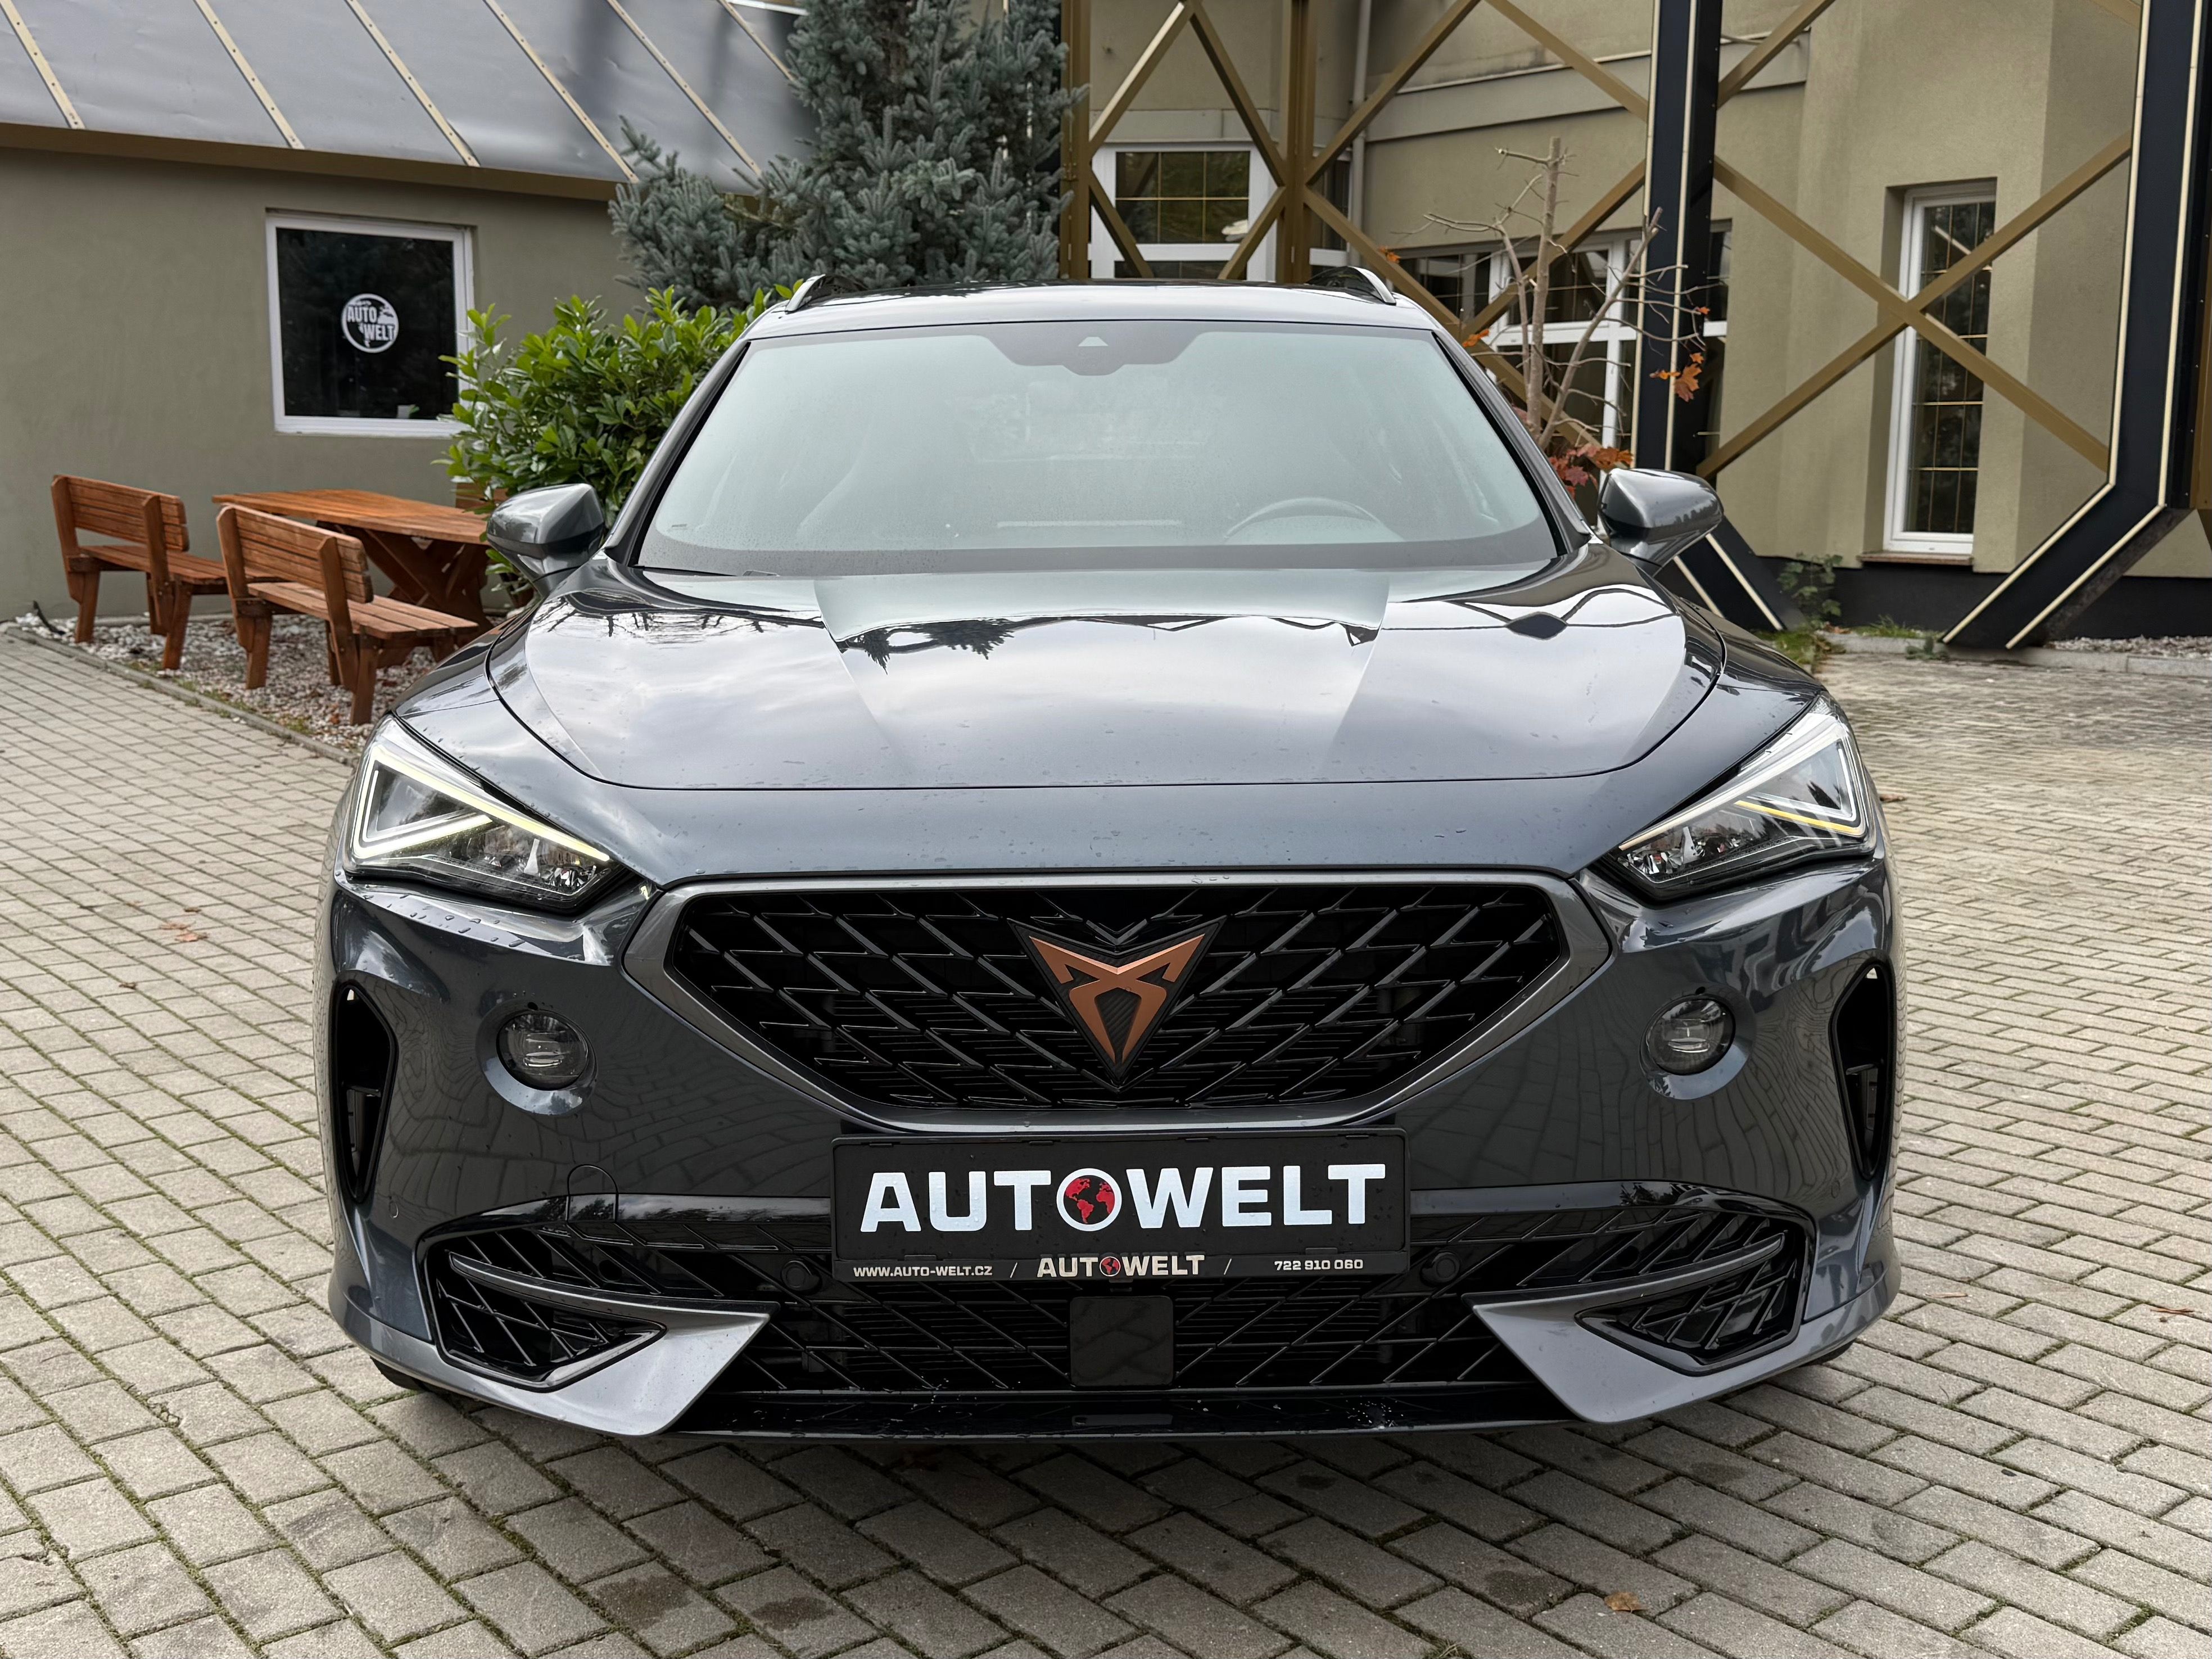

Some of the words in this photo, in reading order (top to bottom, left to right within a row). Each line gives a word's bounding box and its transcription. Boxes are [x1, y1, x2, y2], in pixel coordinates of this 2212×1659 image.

[347, 306, 377, 323] AUTO
[364, 324, 393, 341] WELT
[860, 1163, 1386, 1232] AUTOWELT
[853, 1265, 993, 1277] WWW.AUTO-WELT.CZ
[1274, 1260, 1301, 1271] 722
[1304, 1260, 1331, 1271] 910
[1334, 1259, 1363, 1269] 060
